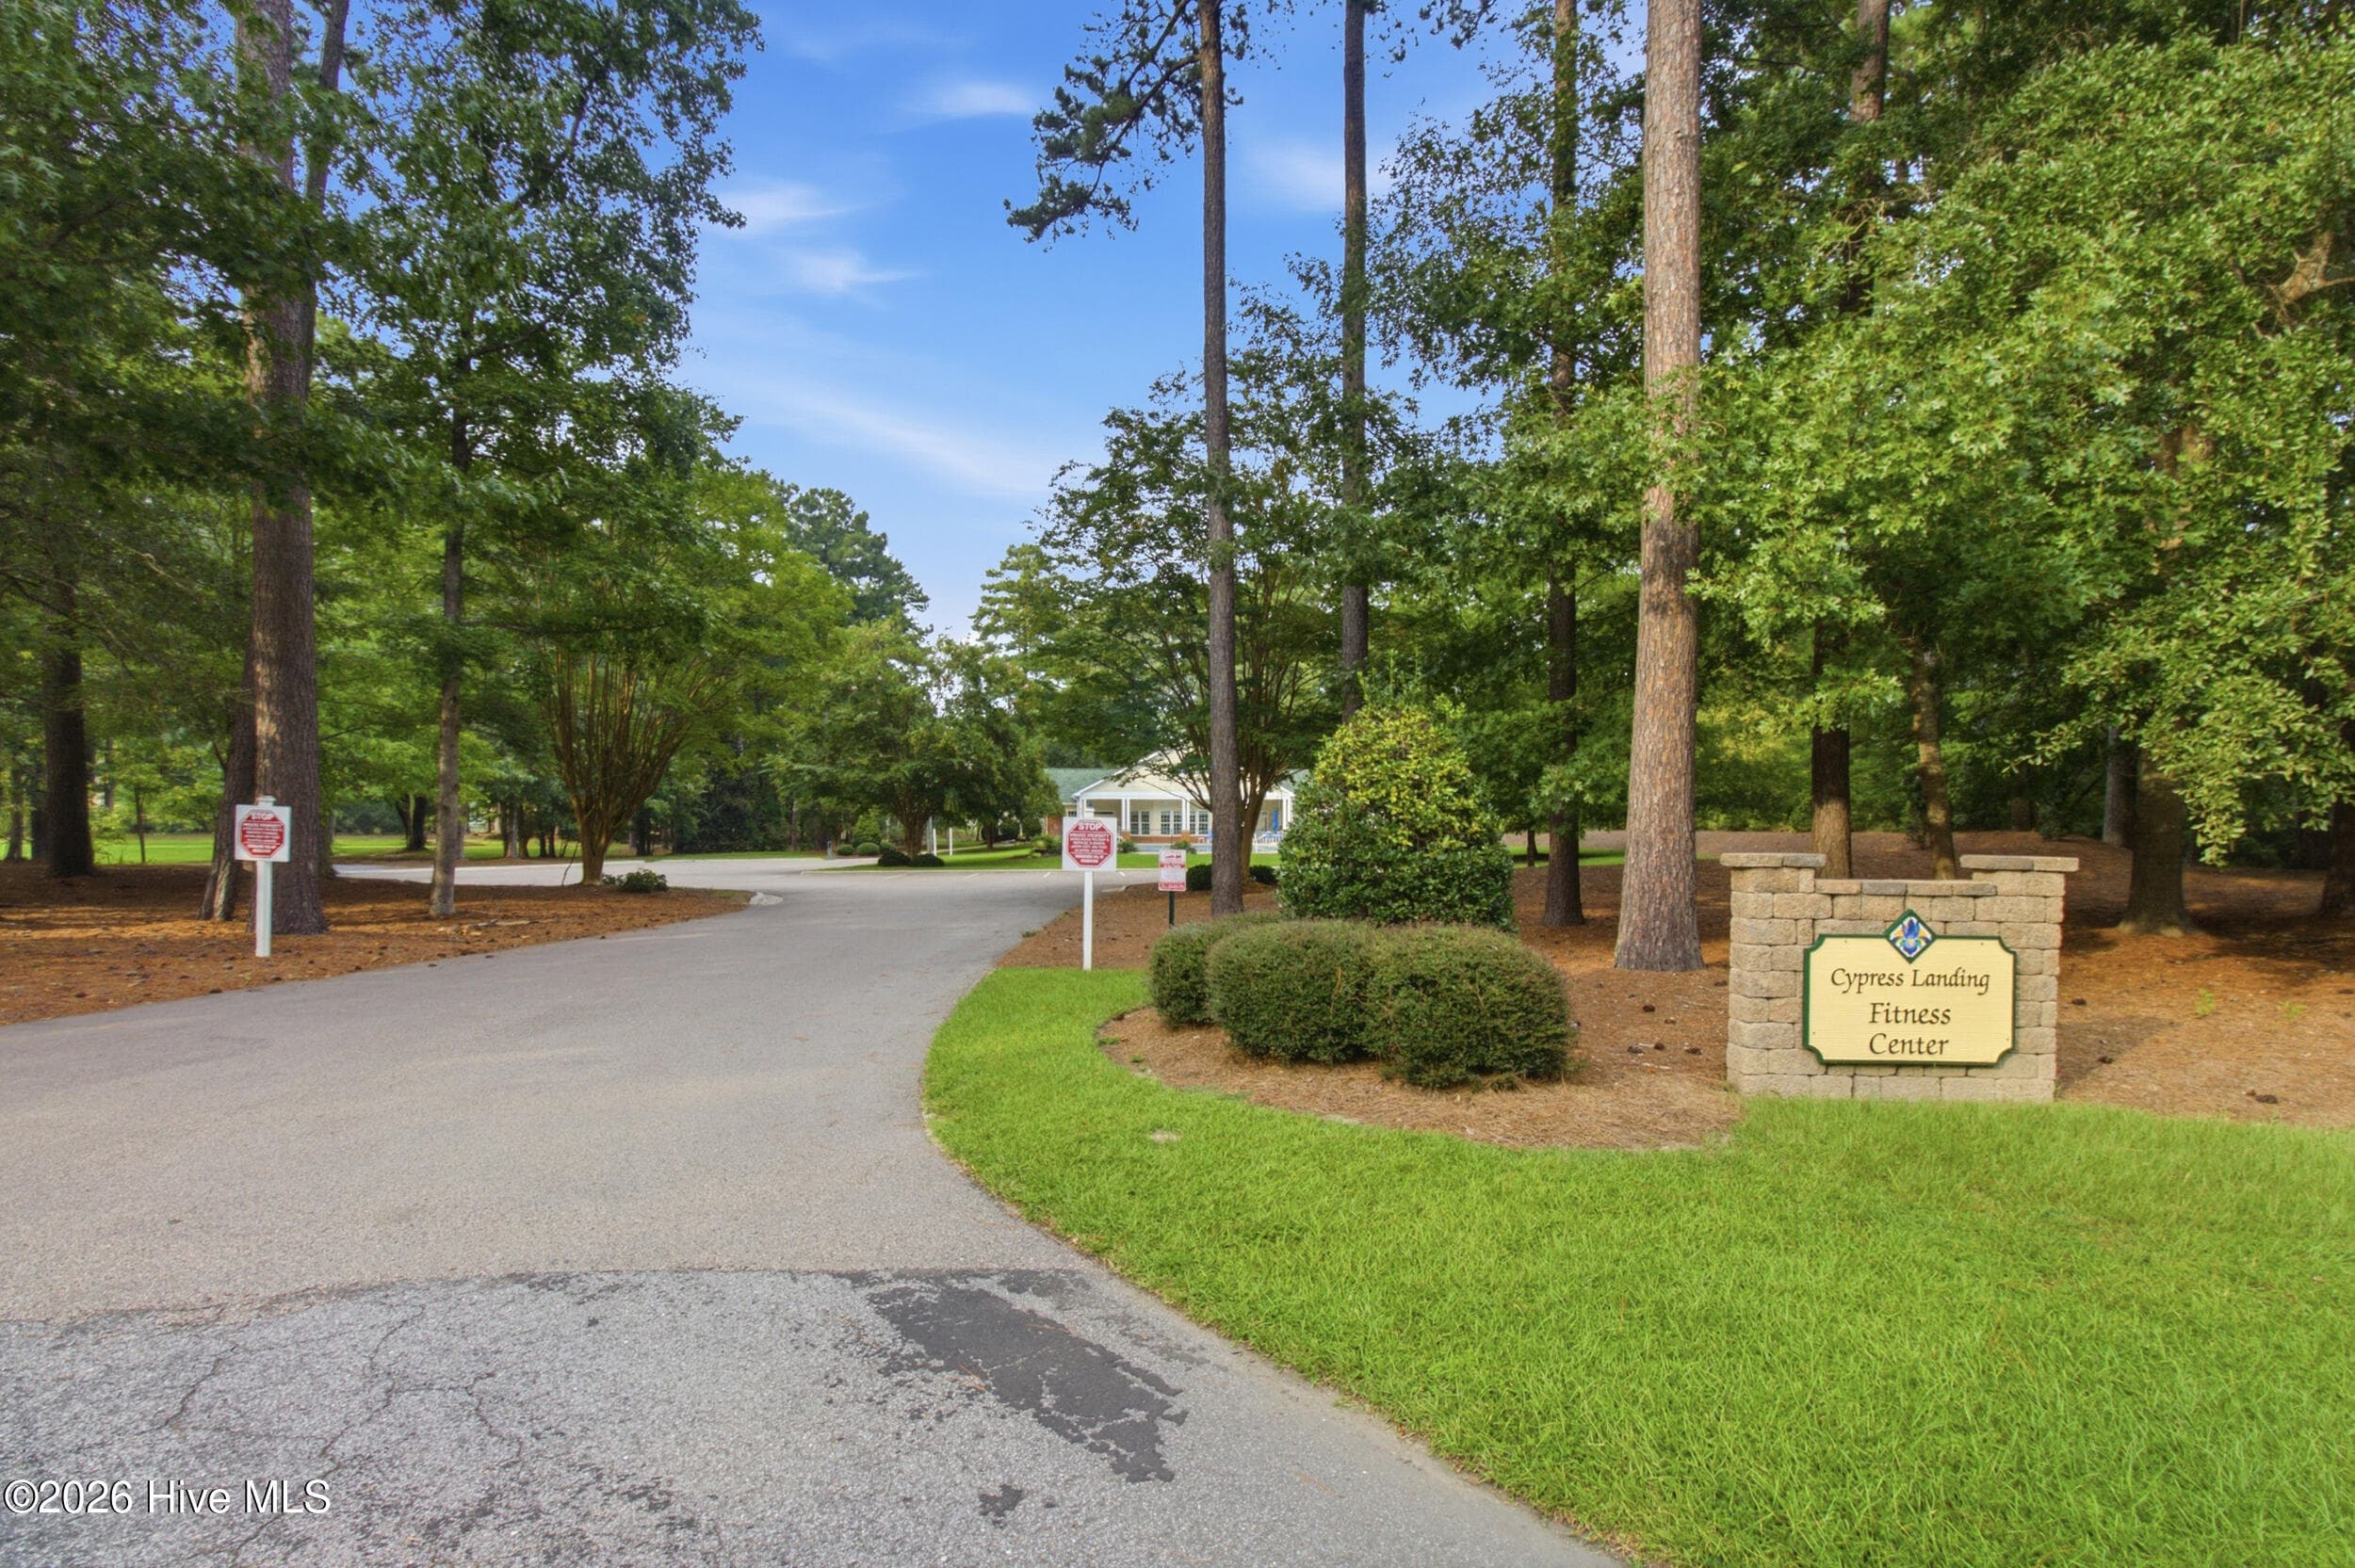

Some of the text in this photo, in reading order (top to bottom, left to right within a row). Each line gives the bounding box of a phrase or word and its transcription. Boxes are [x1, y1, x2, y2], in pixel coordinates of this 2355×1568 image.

[1078, 822, 1102, 831] STOP
[1830, 966, 1990, 995] Cypress Landing
[1868, 1001, 1952, 1026] Fitness
[1869, 1032, 1950, 1056] Center
